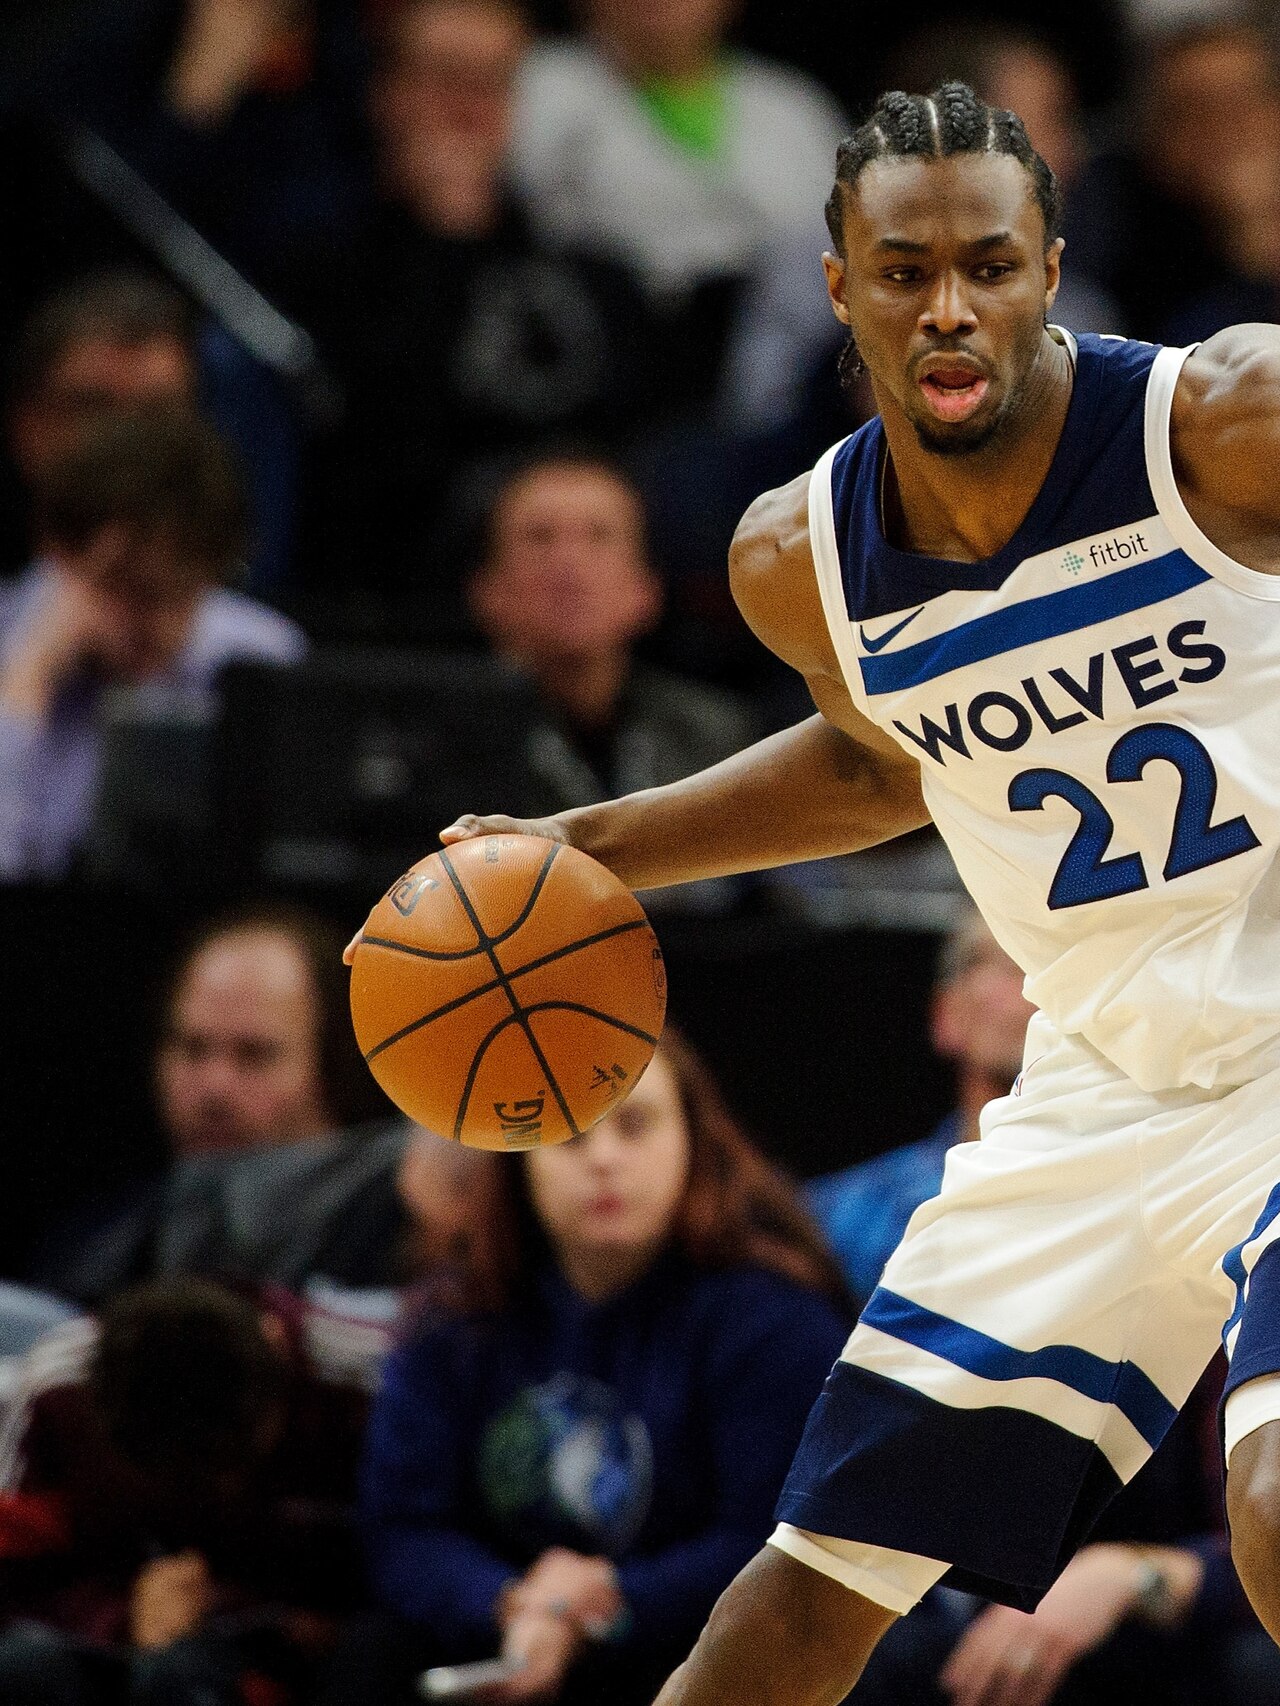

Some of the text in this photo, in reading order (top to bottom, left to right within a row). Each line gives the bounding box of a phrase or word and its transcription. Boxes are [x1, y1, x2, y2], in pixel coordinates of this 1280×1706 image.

[1089, 533, 1149, 567] fitbit
[893, 620, 1226, 766] WOLVES
[1008, 722, 1261, 910] 22
